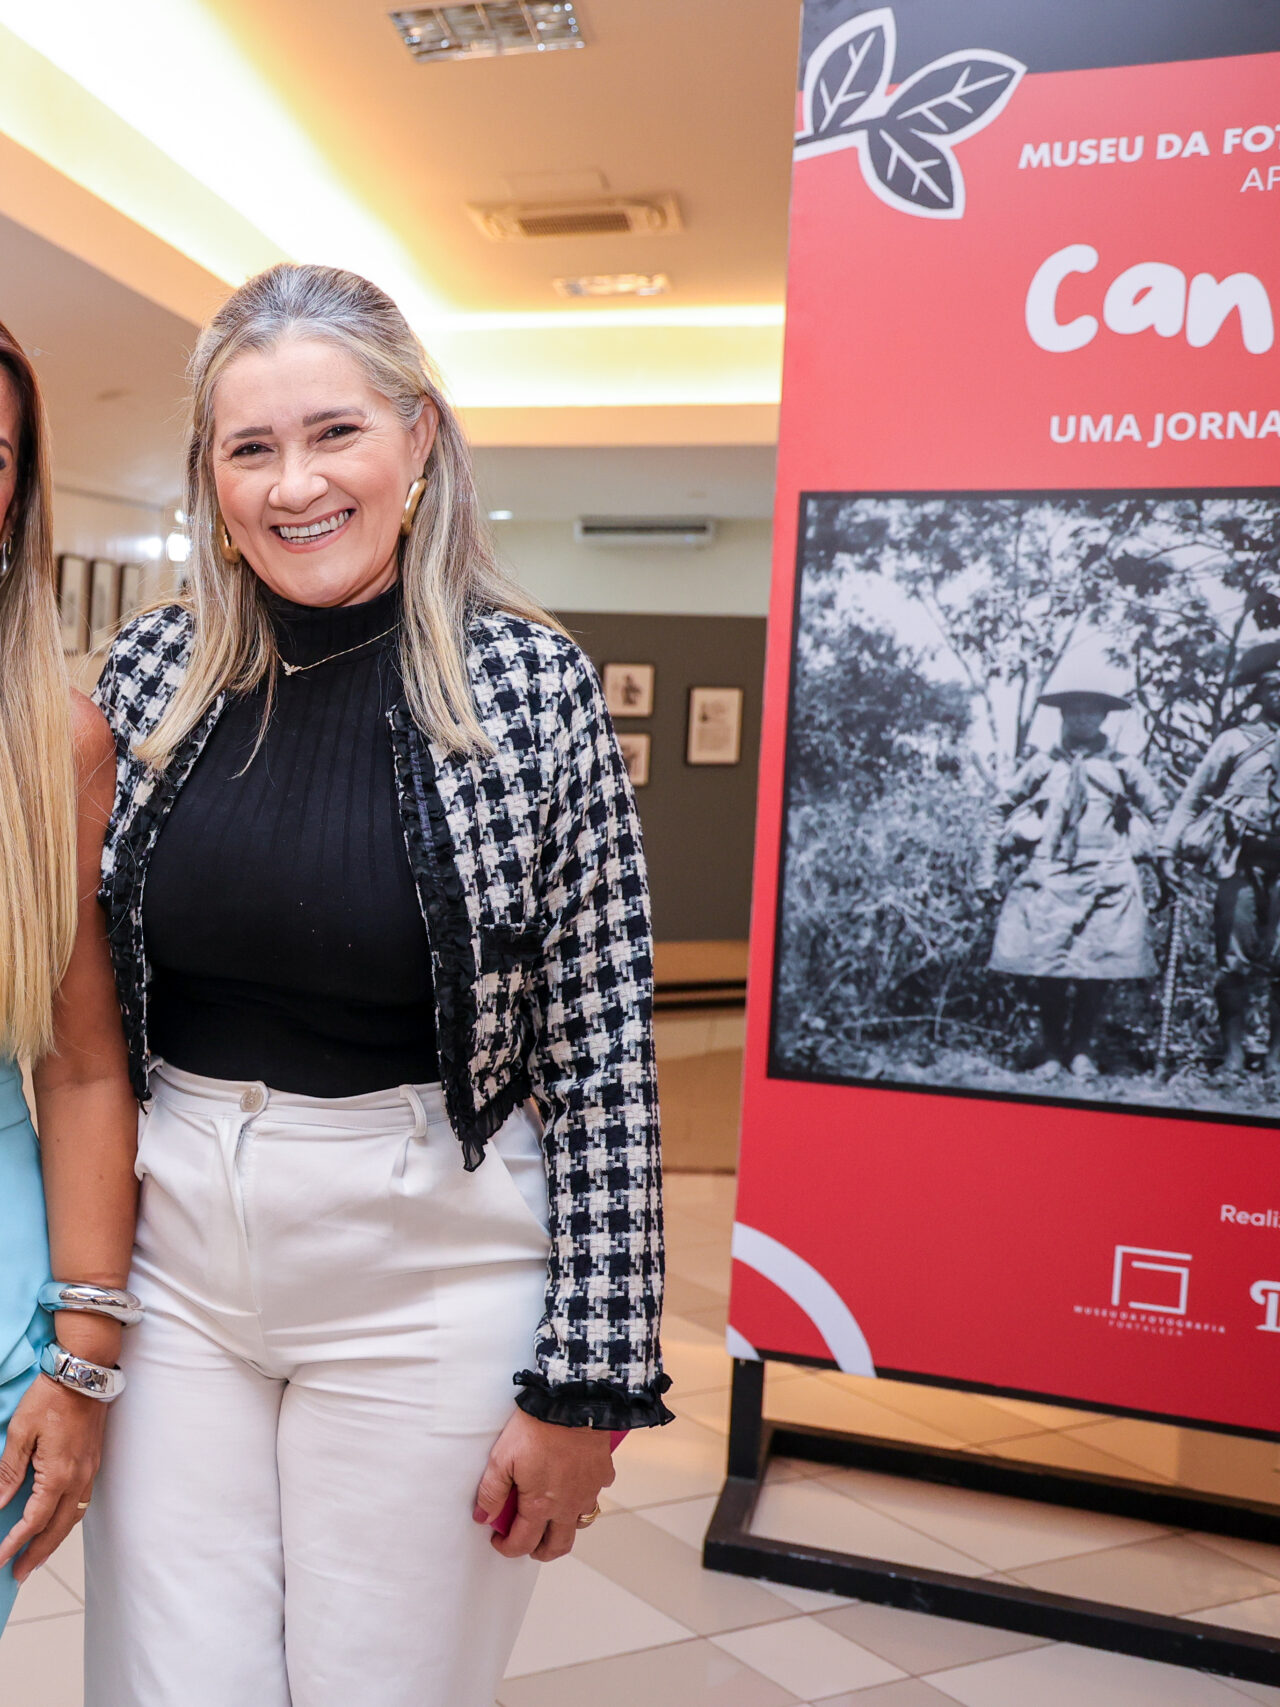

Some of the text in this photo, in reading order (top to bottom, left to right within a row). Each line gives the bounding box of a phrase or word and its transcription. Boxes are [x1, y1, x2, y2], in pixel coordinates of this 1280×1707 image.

[1018, 124, 1280, 169] MUSEU DA FO
[1025, 243, 1275, 355] Can
[1049, 409, 1280, 449] UMA JORNA
[1220, 1204, 1280, 1229] Reali
